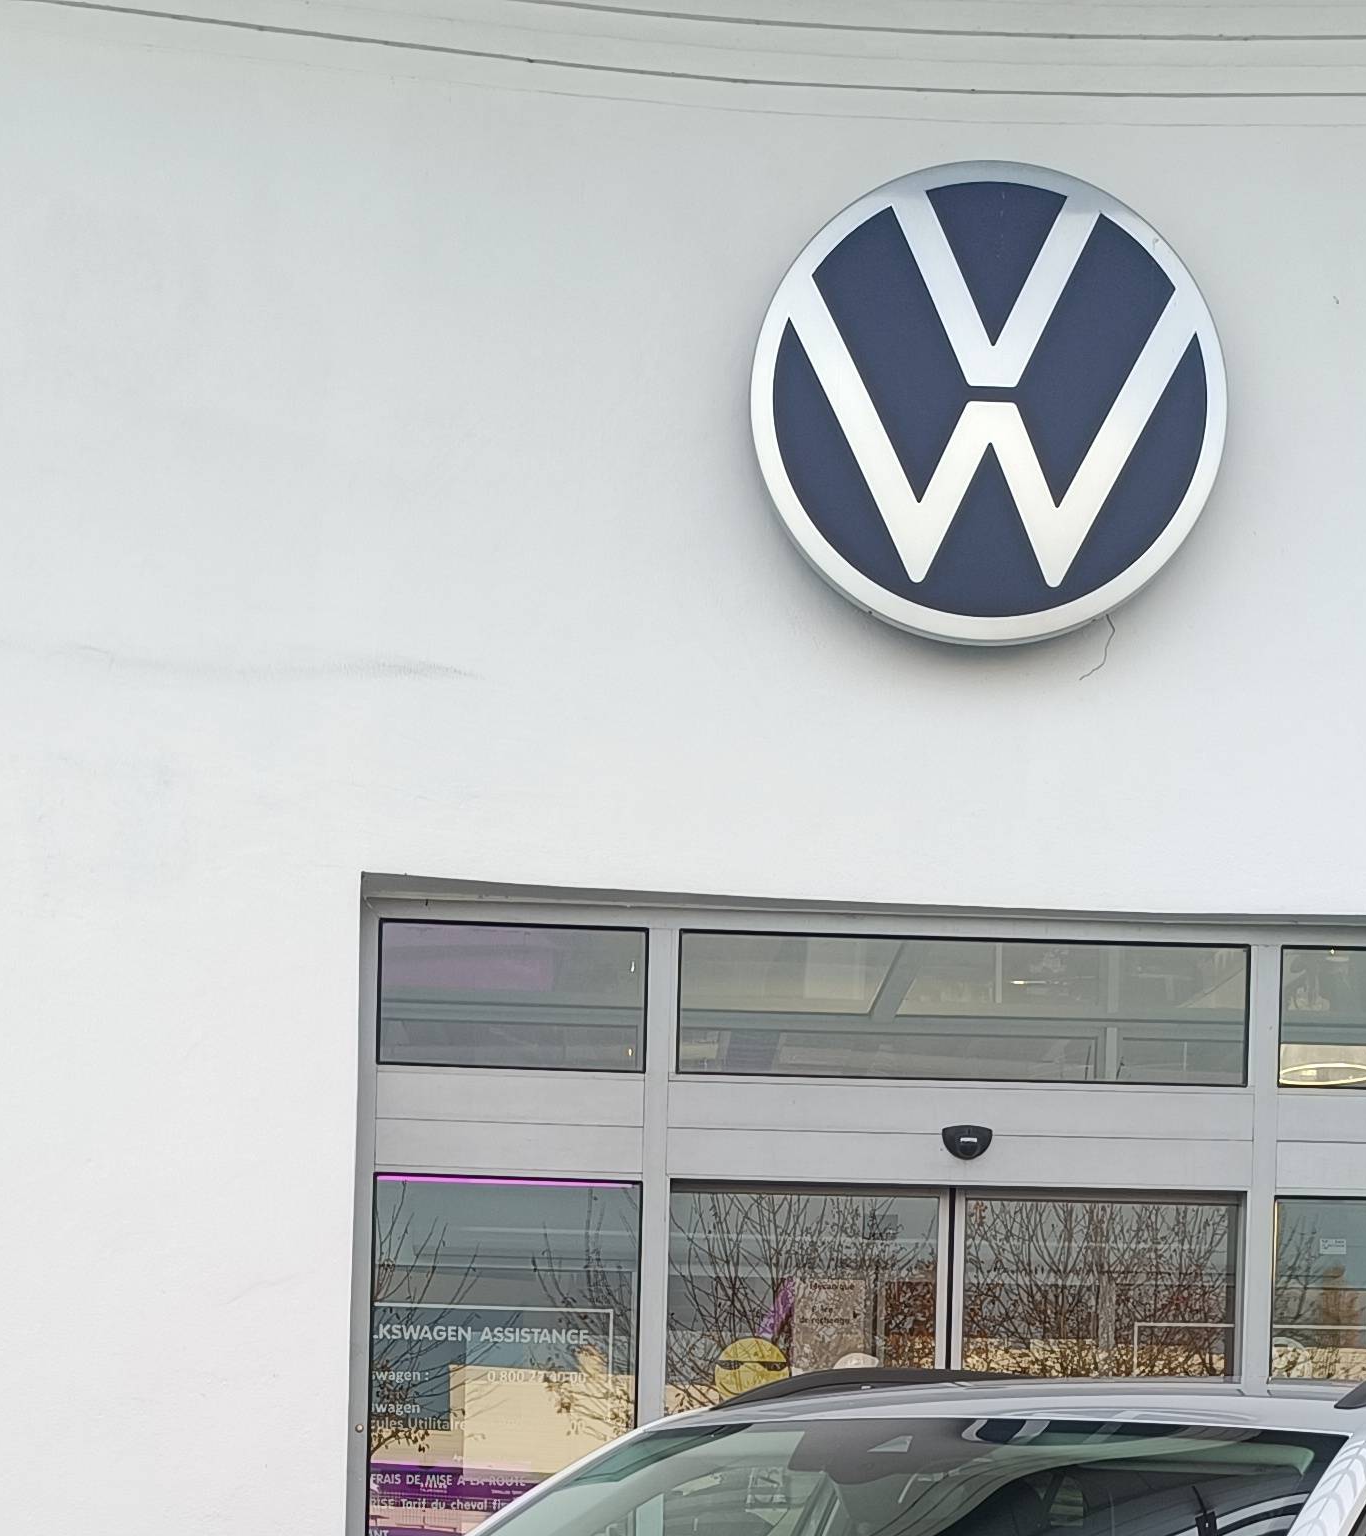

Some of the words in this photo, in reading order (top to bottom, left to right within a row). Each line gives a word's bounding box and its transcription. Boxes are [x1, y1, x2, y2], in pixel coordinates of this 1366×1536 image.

[481, 1326, 590, 1344] ASSISTANCE
[371, 1403, 421, 1416] wagen
[370, 1474, 401, 1486] FRAIS
[406, 1474, 421, 1486] DE
[427, 1474, 453, 1487] MISE
[400, 1498, 427, 1510] Tarif
[431, 1498, 446, 1510] du
[450, 1498, 487, 1511] cheval
